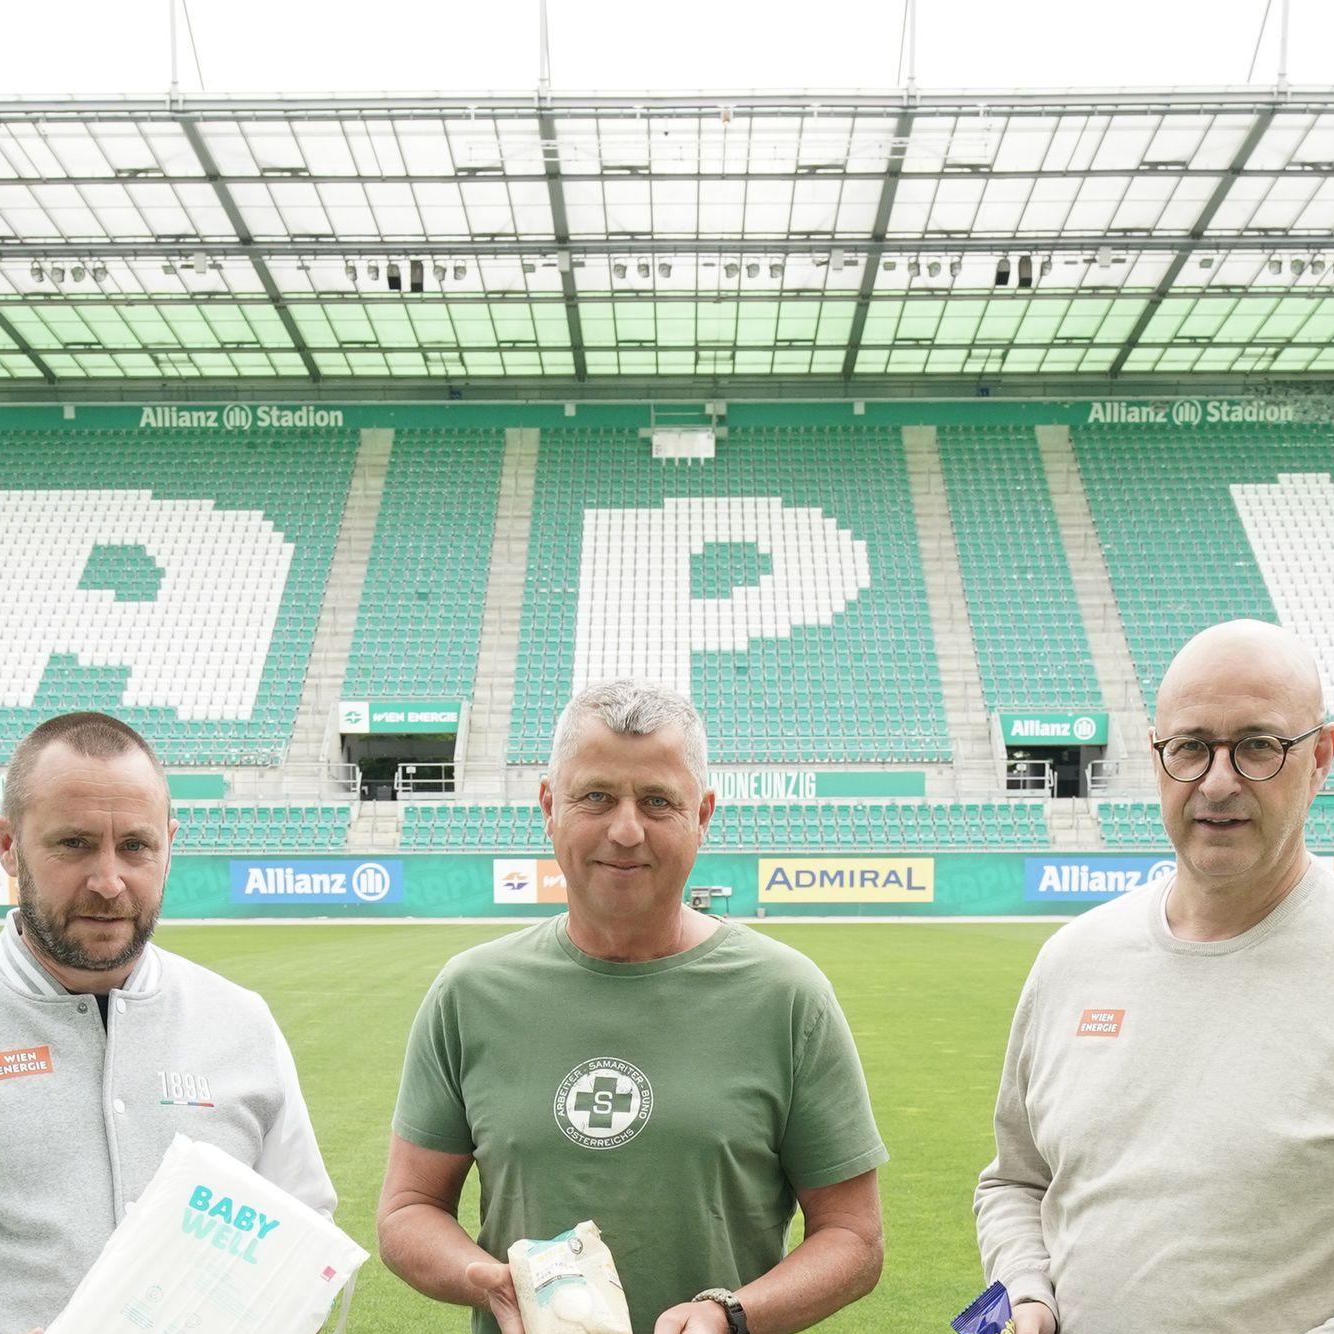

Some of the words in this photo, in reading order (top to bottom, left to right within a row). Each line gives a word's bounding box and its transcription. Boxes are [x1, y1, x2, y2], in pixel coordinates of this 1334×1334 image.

[139, 406, 218, 428] Allianz
[256, 405, 343, 428] Stadion
[1088, 402, 1167, 423] Allianz
[1206, 401, 1293, 422] Stadion
[1010, 719, 1071, 738] Allianz
[244, 867, 347, 894] Allianz
[765, 867, 927, 891] ADMIRAL
[1038, 865, 1141, 892] Allianz
[1080, 1023, 1118, 1034] ENERGIE
[1090, 1013, 1114, 1023] WIEN
[3, 1051, 37, 1064] WIEN
[158, 1071, 212, 1101] 1899
[556, 1070, 583, 1117] ARBEITER
[588, 1060, 644, 1086] SAMARITER
[638, 1089, 650, 1120] BUND
[593, 1091, 613, 1114] S
[188, 1184, 281, 1240] BABY
[180, 1207, 258, 1265] WELL
